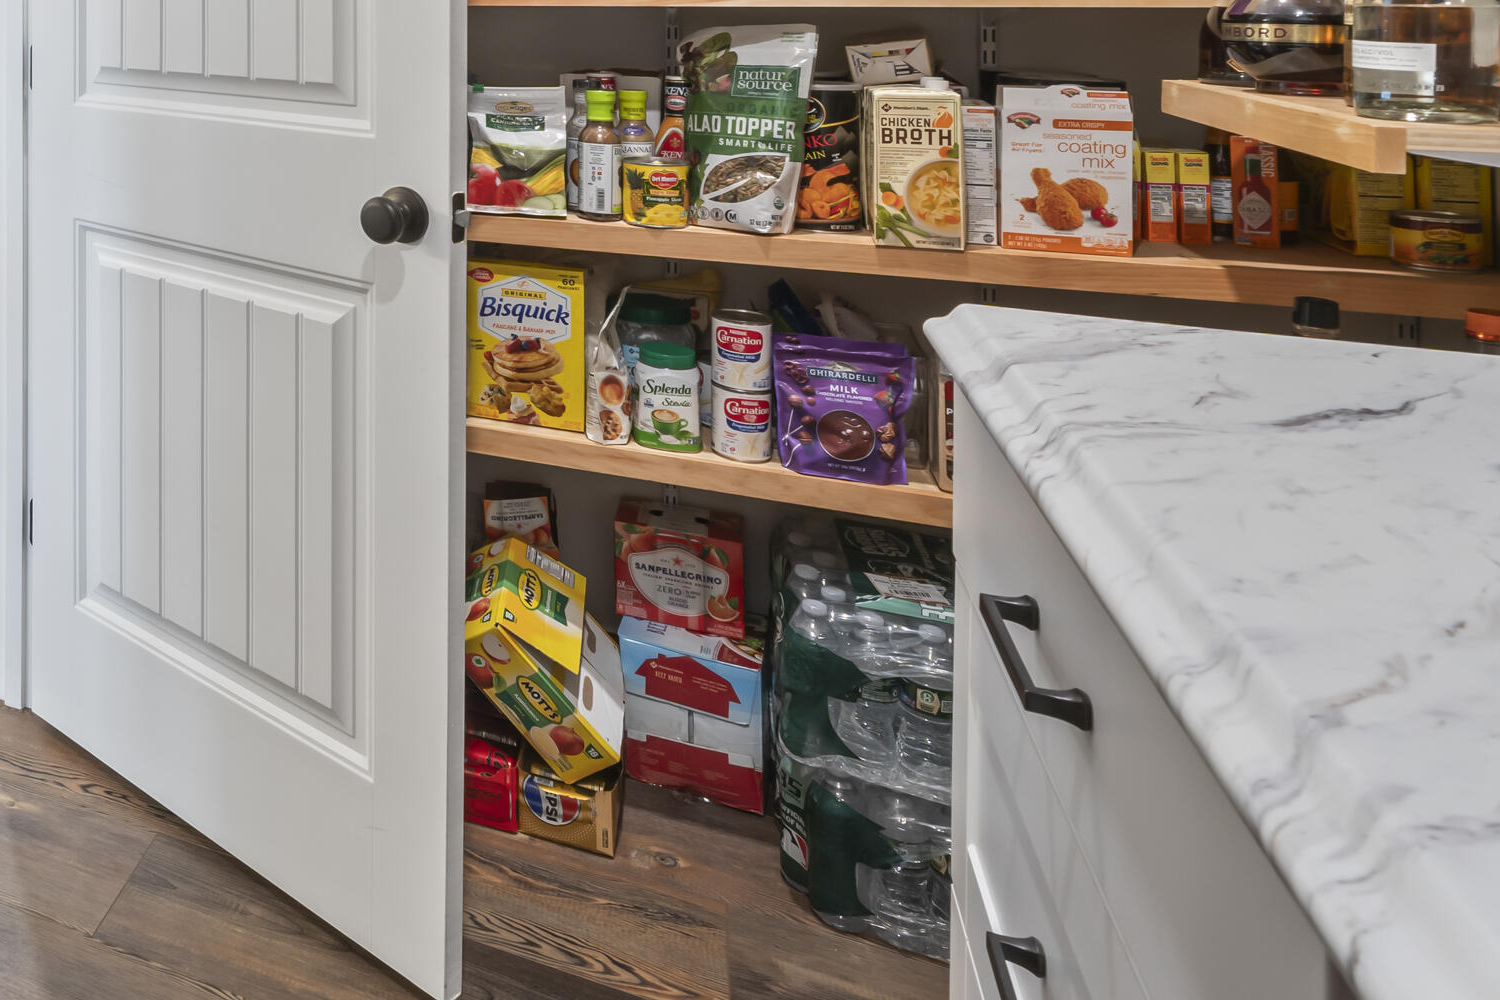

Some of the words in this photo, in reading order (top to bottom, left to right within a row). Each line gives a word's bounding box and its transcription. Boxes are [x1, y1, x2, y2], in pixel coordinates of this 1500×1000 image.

[736, 78, 793, 92] source
[1070, 101, 1107, 111] coating
[687, 114, 721, 133] ALAD
[725, 115, 797, 140] TOPPER
[880, 117, 931, 128] CHICKEN
[805, 133, 838, 149] NKO
[881, 127, 952, 146] BROTH
[1042, 131, 1093, 140] seasoned
[718, 137, 756, 149] SMART
[768, 141, 793, 152] LIFE
[1057, 140, 1127, 158] coating
[661, 150, 684, 160] KEN
[805, 150, 826, 160] AIN
[1082, 156, 1115, 169] mix
[1259, 142, 1275, 178] LASSIC
[562, 278, 576, 287] 60
[504, 290, 544, 299] ORIGINAL
[479, 296, 570, 326] Bisquick
[717, 329, 762, 346] Carnation
[809, 368, 877, 383] GHIRARDELLI
[642, 378, 692, 396] Splenda
[829, 384, 860, 395] MILK
[726, 400, 770, 416] Carnation
[634, 561, 722, 586] SANPELLEGRINO
[656, 584, 682, 597] ZERO
[520, 680, 559, 720] MOTT'S
[545, 789, 560, 823] EPSI
